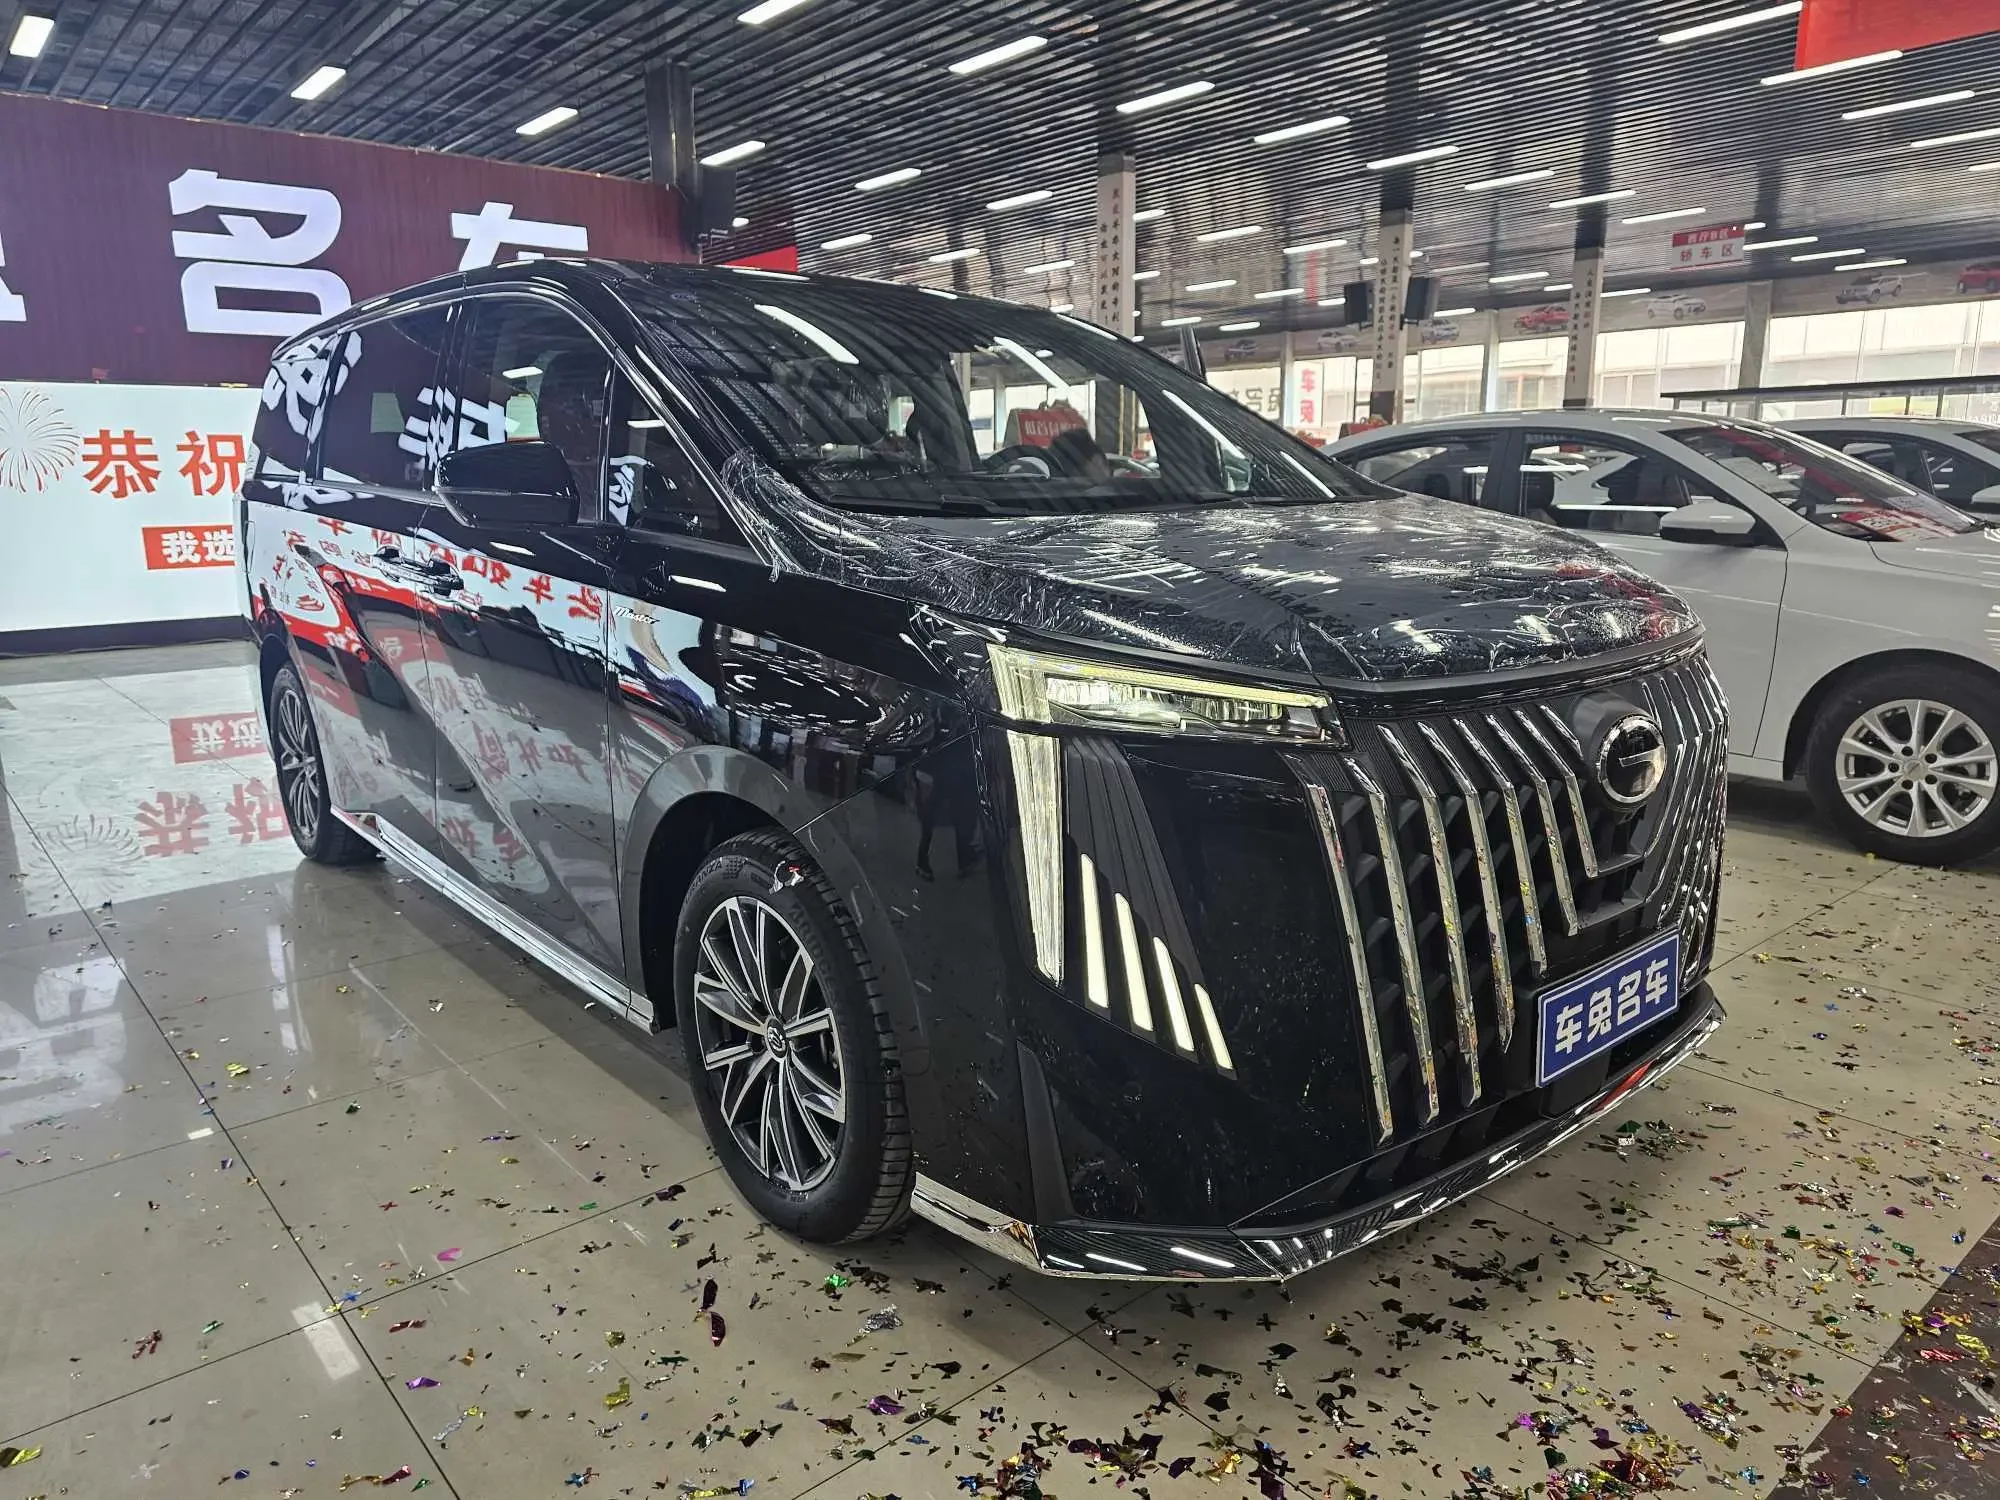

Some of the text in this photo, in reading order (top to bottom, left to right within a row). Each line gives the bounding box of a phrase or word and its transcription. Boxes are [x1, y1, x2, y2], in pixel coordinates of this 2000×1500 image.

[82, 429, 246, 499] 恭祝
[1555, 958, 1669, 1054] 车兔名车
